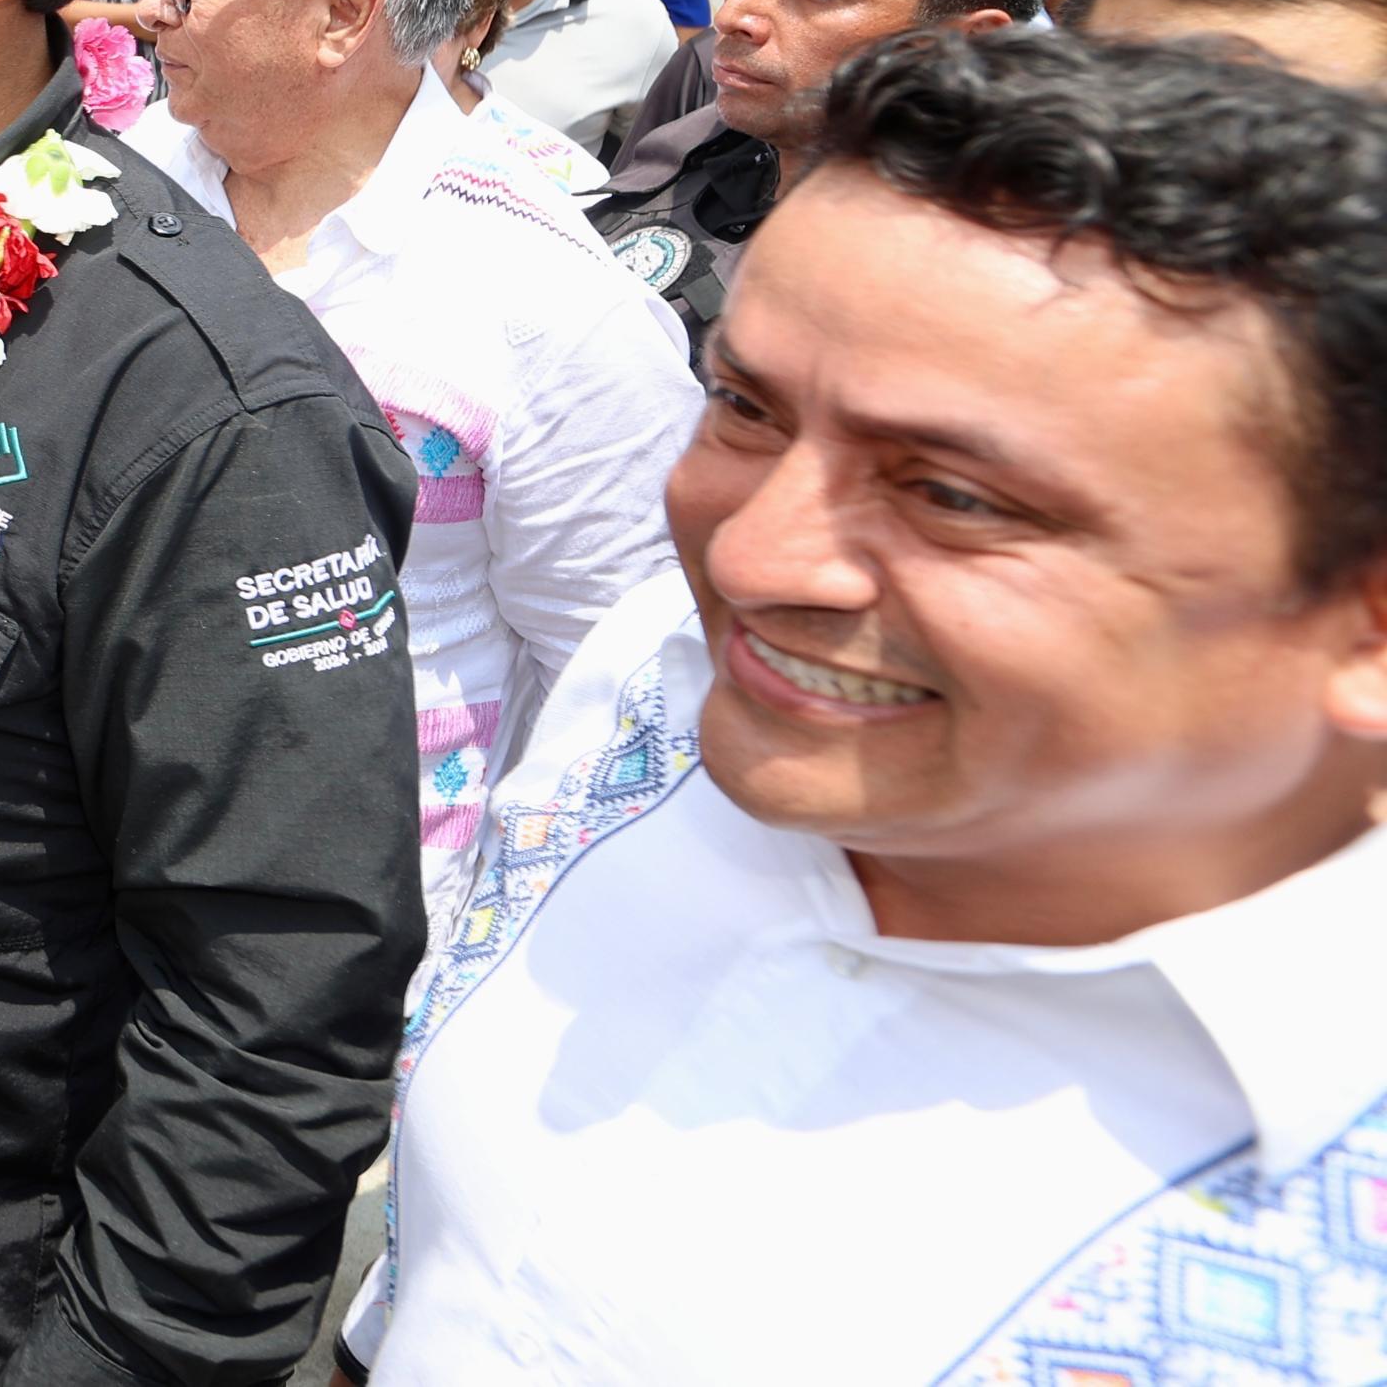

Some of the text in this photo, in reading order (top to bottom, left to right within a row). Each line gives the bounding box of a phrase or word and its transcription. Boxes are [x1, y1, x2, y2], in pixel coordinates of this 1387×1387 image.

[245, 575, 374, 630] DE SALUD
[262, 626, 372, 668] GOBIERNO DE
